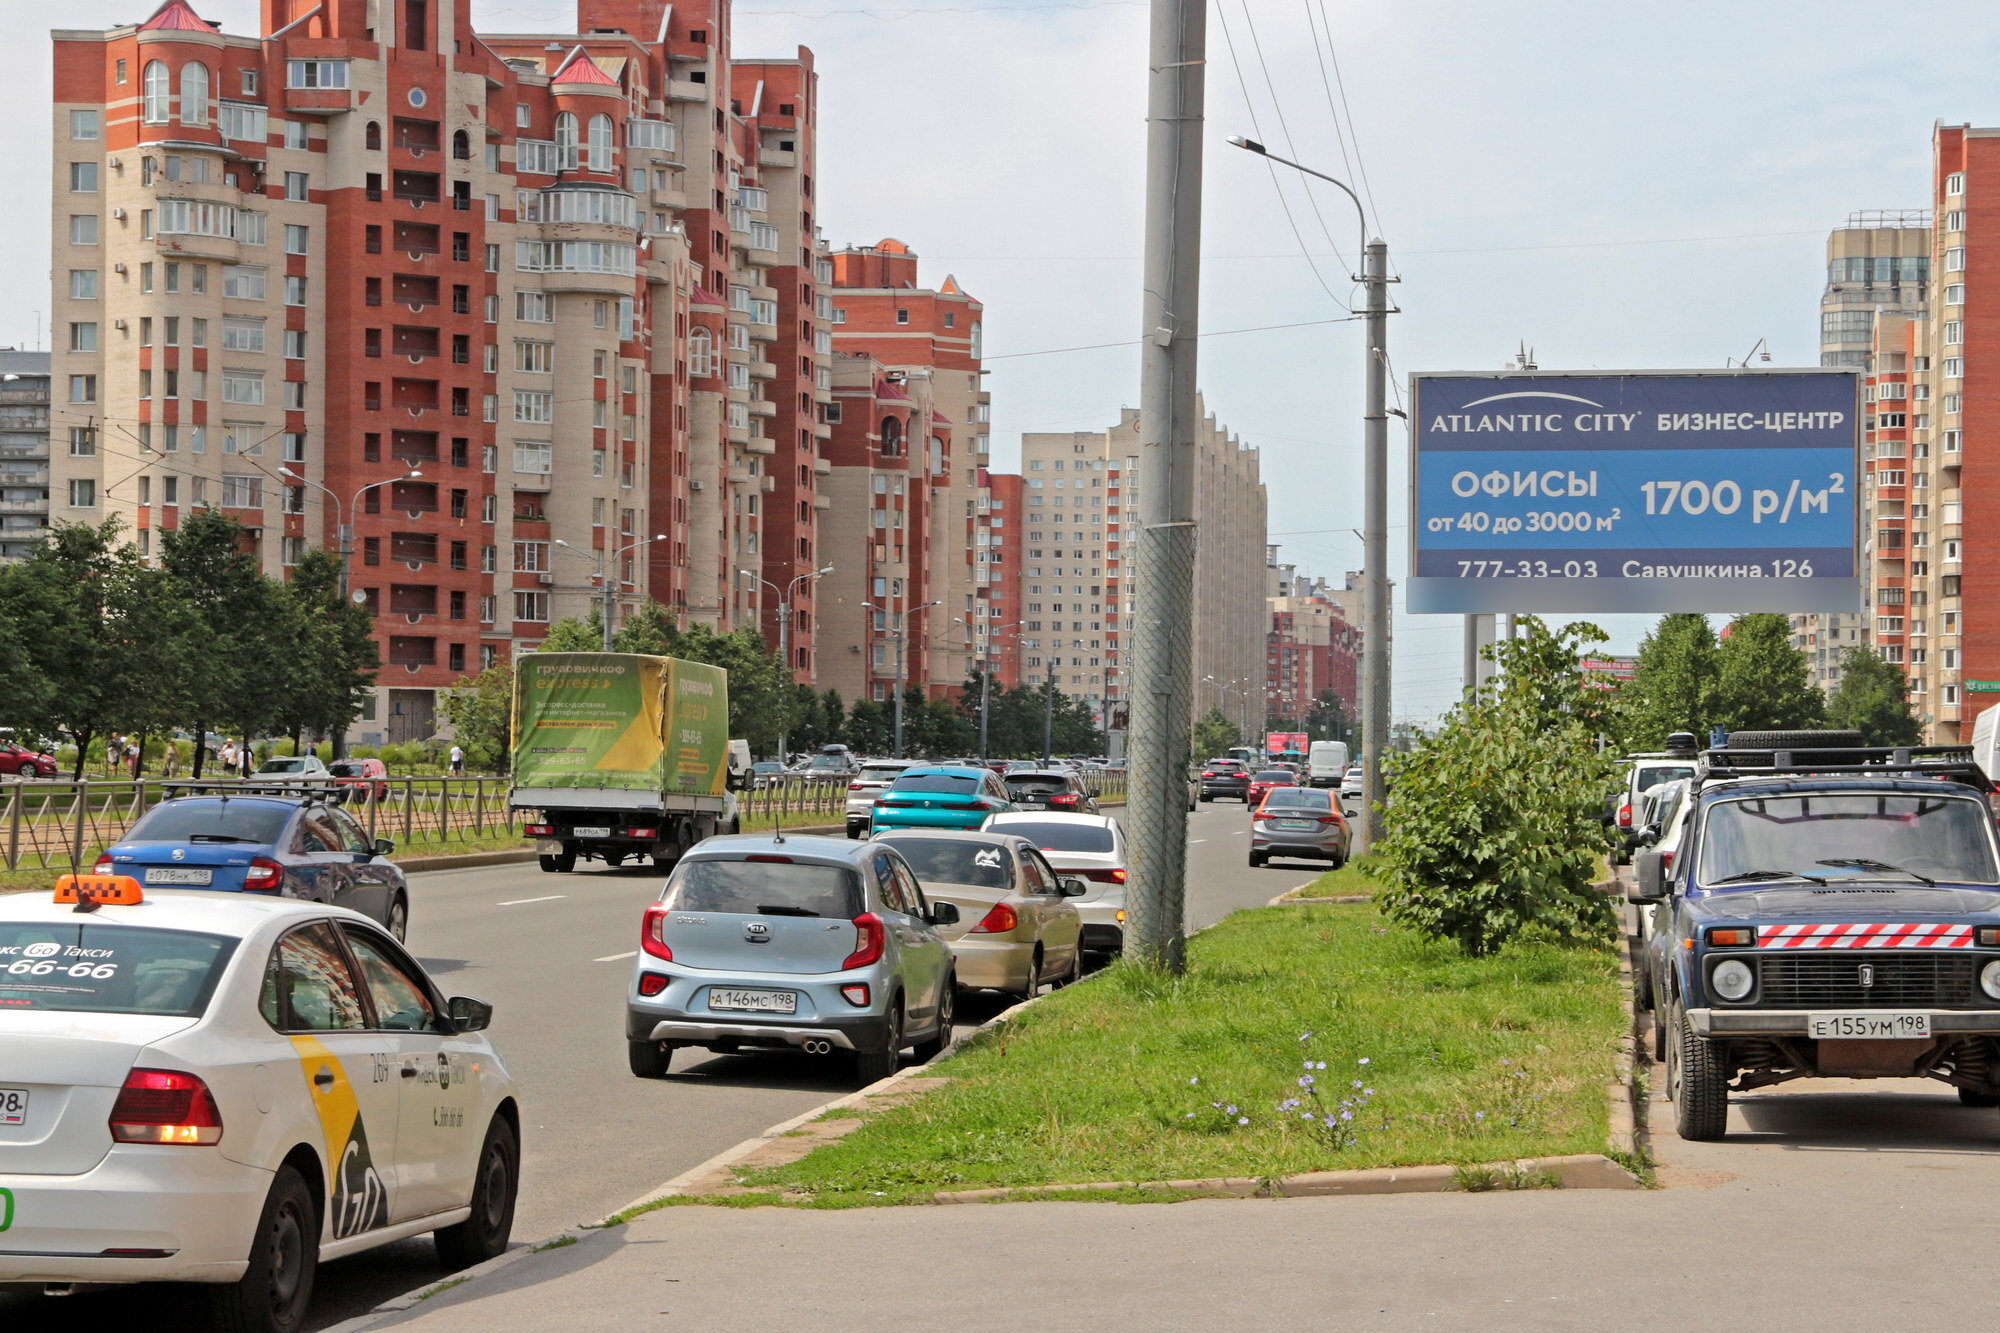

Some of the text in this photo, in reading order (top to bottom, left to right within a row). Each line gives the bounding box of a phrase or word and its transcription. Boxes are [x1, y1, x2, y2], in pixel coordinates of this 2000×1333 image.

[1430, 414, 1562, 432] ATLANTIC
[1657, 411, 1844, 432] БИЗНЕС-ЦЕНТР
[1451, 470, 1597, 498] ОФИСЫ
[1640, 480, 1742, 515] 1700
[1427, 517, 1455, 532] от
[1456, 511, 1490, 532] 40
[1492, 517, 1523, 534] до
[1525, 511, 1592, 532] 3000
[1457, 560, 1598, 578] 777-33-03
[750, 924, 765, 933] KIA
[63, 945, 114, 958] Такси
